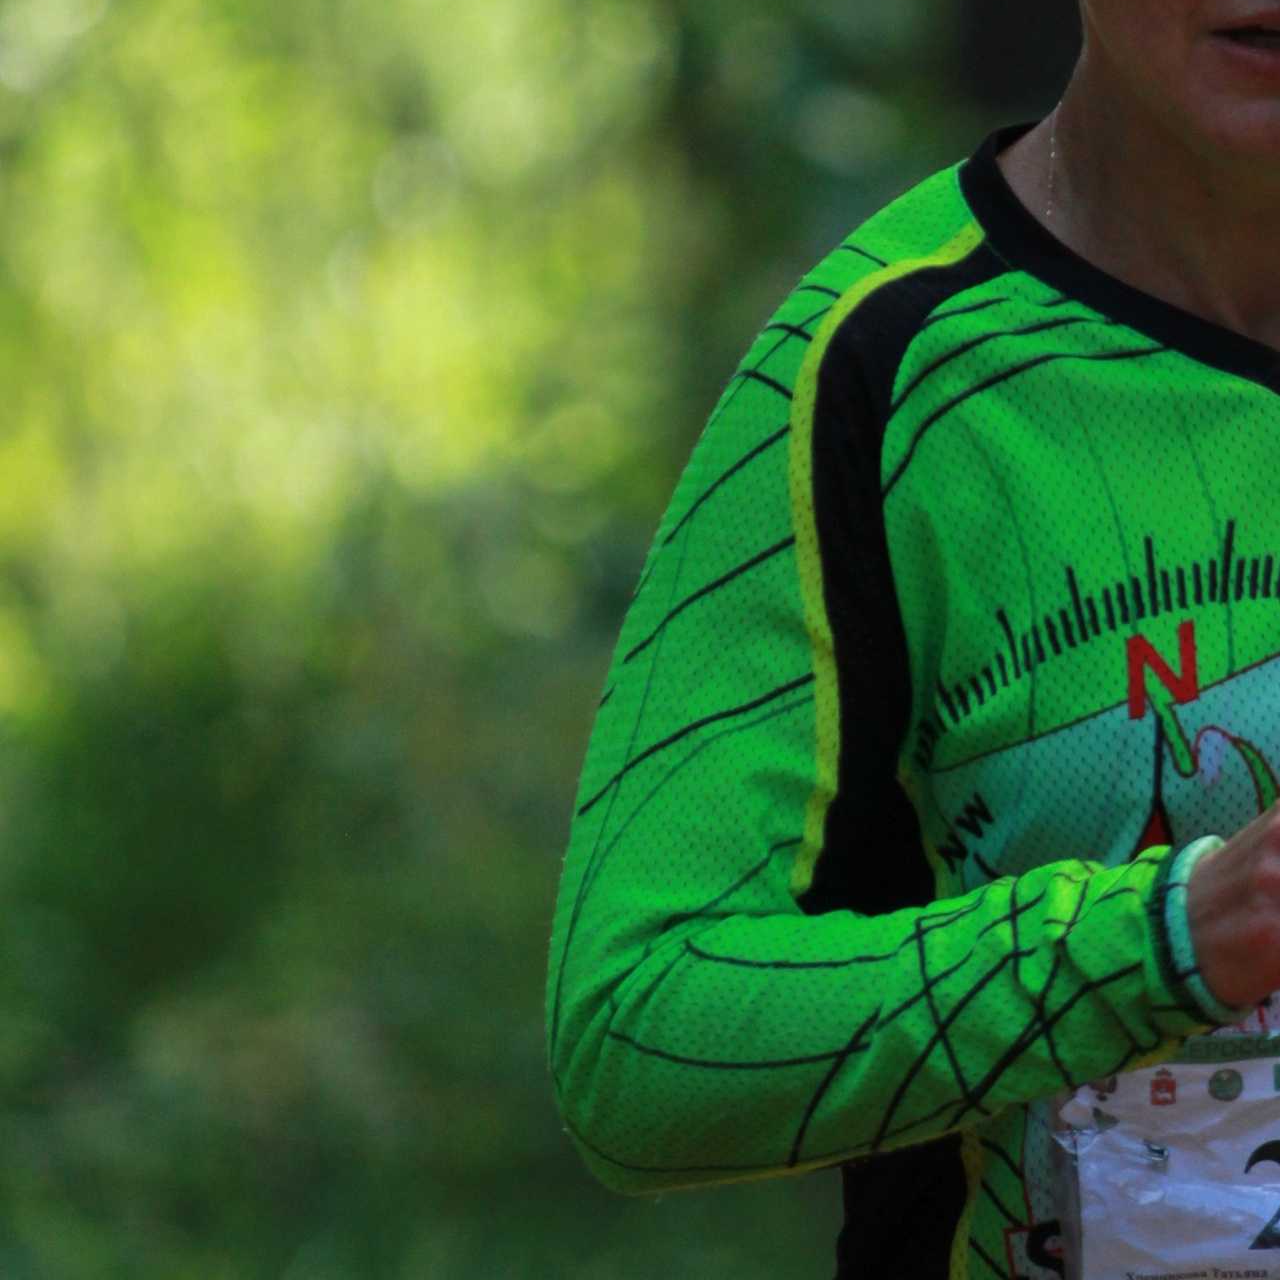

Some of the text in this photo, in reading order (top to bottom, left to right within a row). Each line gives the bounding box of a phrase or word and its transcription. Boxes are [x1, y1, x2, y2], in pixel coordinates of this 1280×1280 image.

[1127, 620, 1199, 720] N
[937, 792, 995, 875] NW
[1211, 1268, 1268, 1279] Татьяна
